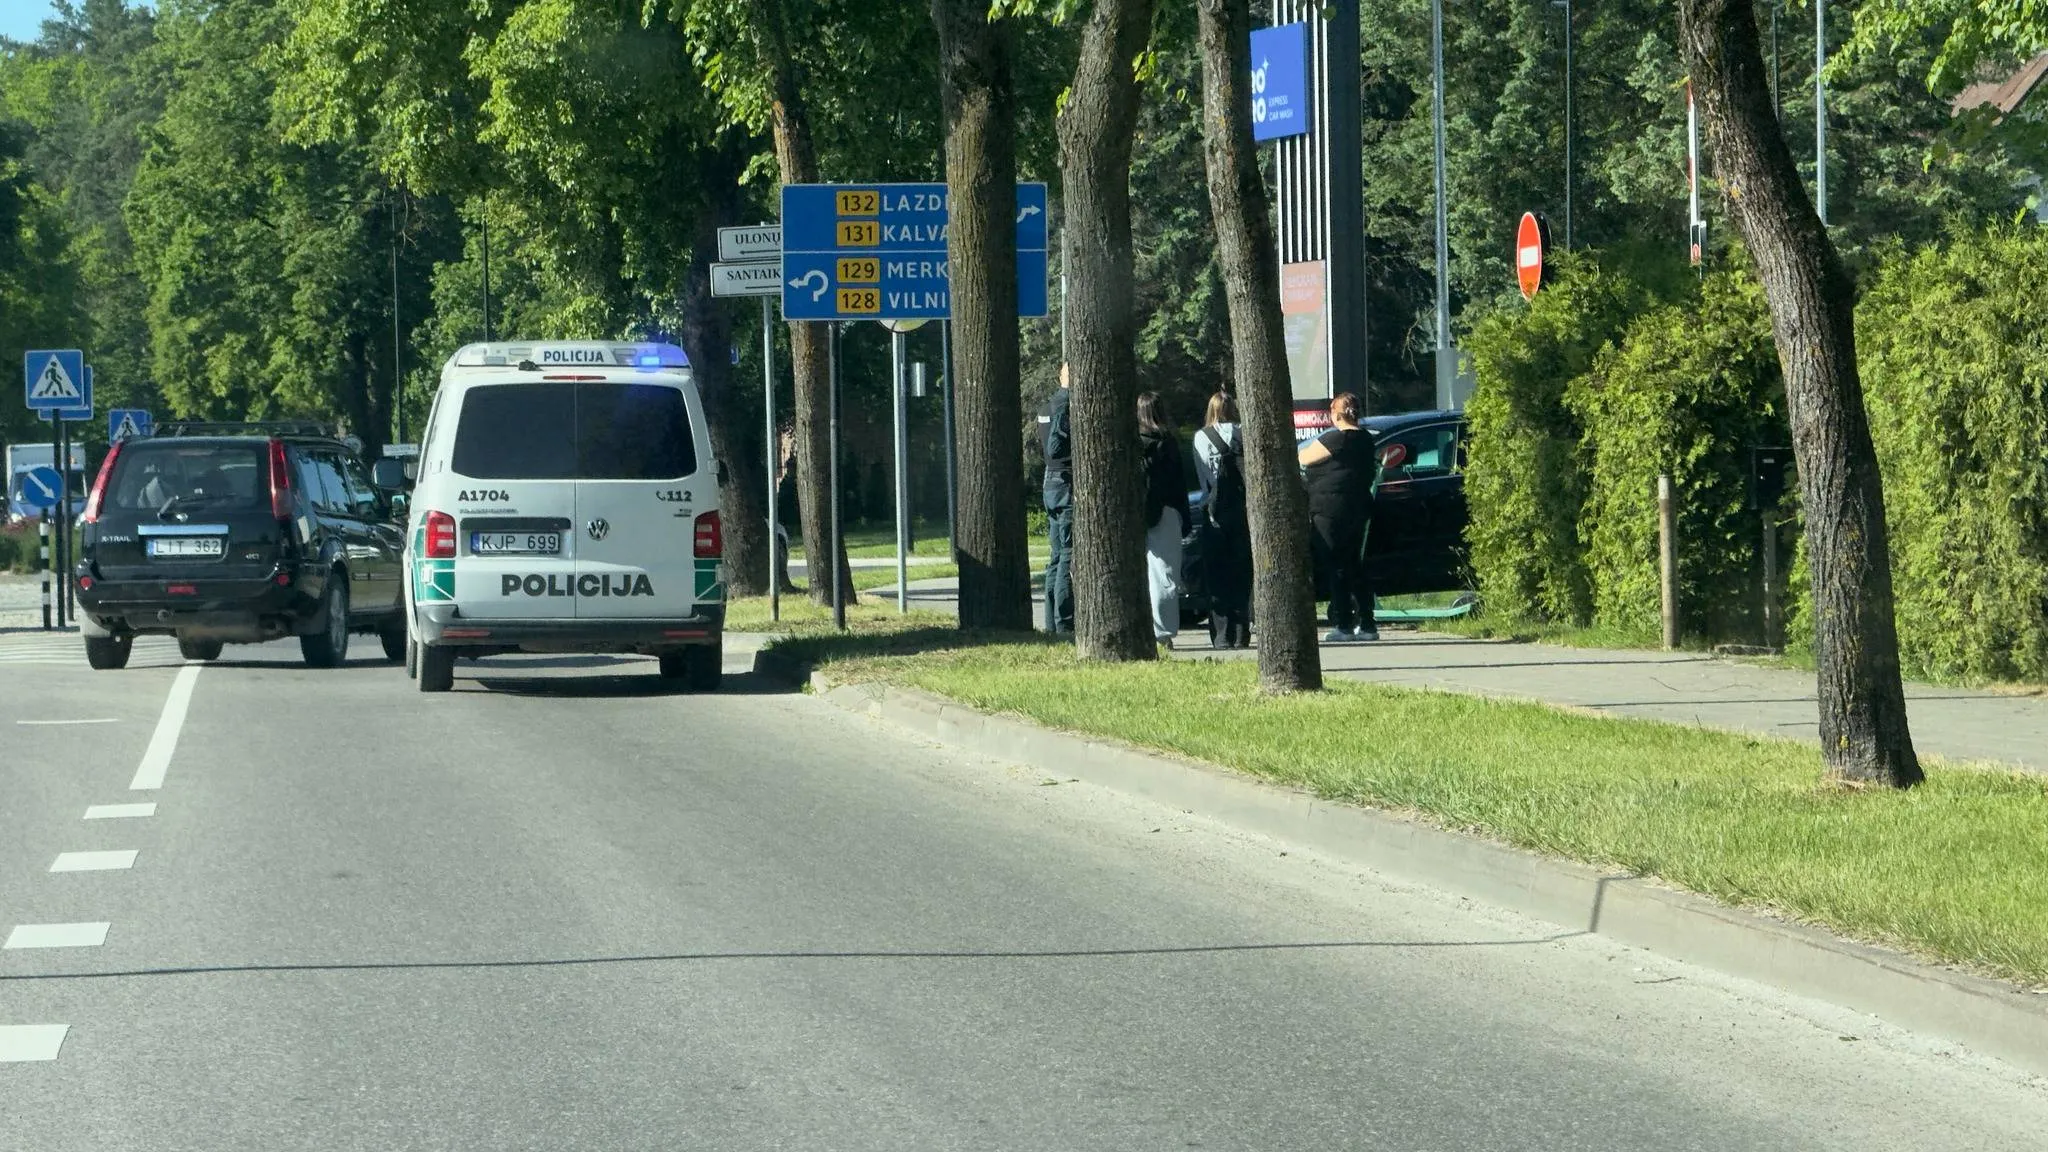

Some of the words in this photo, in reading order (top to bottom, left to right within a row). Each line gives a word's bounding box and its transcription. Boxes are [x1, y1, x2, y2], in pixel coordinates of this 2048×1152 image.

[1268, 95, 1289, 107] EXPRESS
[1268, 110, 1279, 122] CAR
[1279, 108, 1294, 120] WASH
[842, 194, 875, 212] 132
[844, 224, 874, 242] 131
[883, 224, 949, 242] KALVA
[727, 268, 781, 281] SANTAIK
[842, 261, 875, 280] 129
[887, 261, 949, 279] MERK
[842, 291, 875, 309] 128
[888, 291, 947, 309] VILNI
[543, 350, 604, 363] POLICIJA
[458, 490, 510, 502] A1704
[667, 490, 692, 502] 112
[101, 535, 132, 543] X-TRAIL
[482, 535, 516, 551] KJP
[527, 535, 557, 551] 699
[156, 541, 184, 554] LIT
[195, 540, 220, 553] 362
[501, 574, 654, 597] POLICIJA
